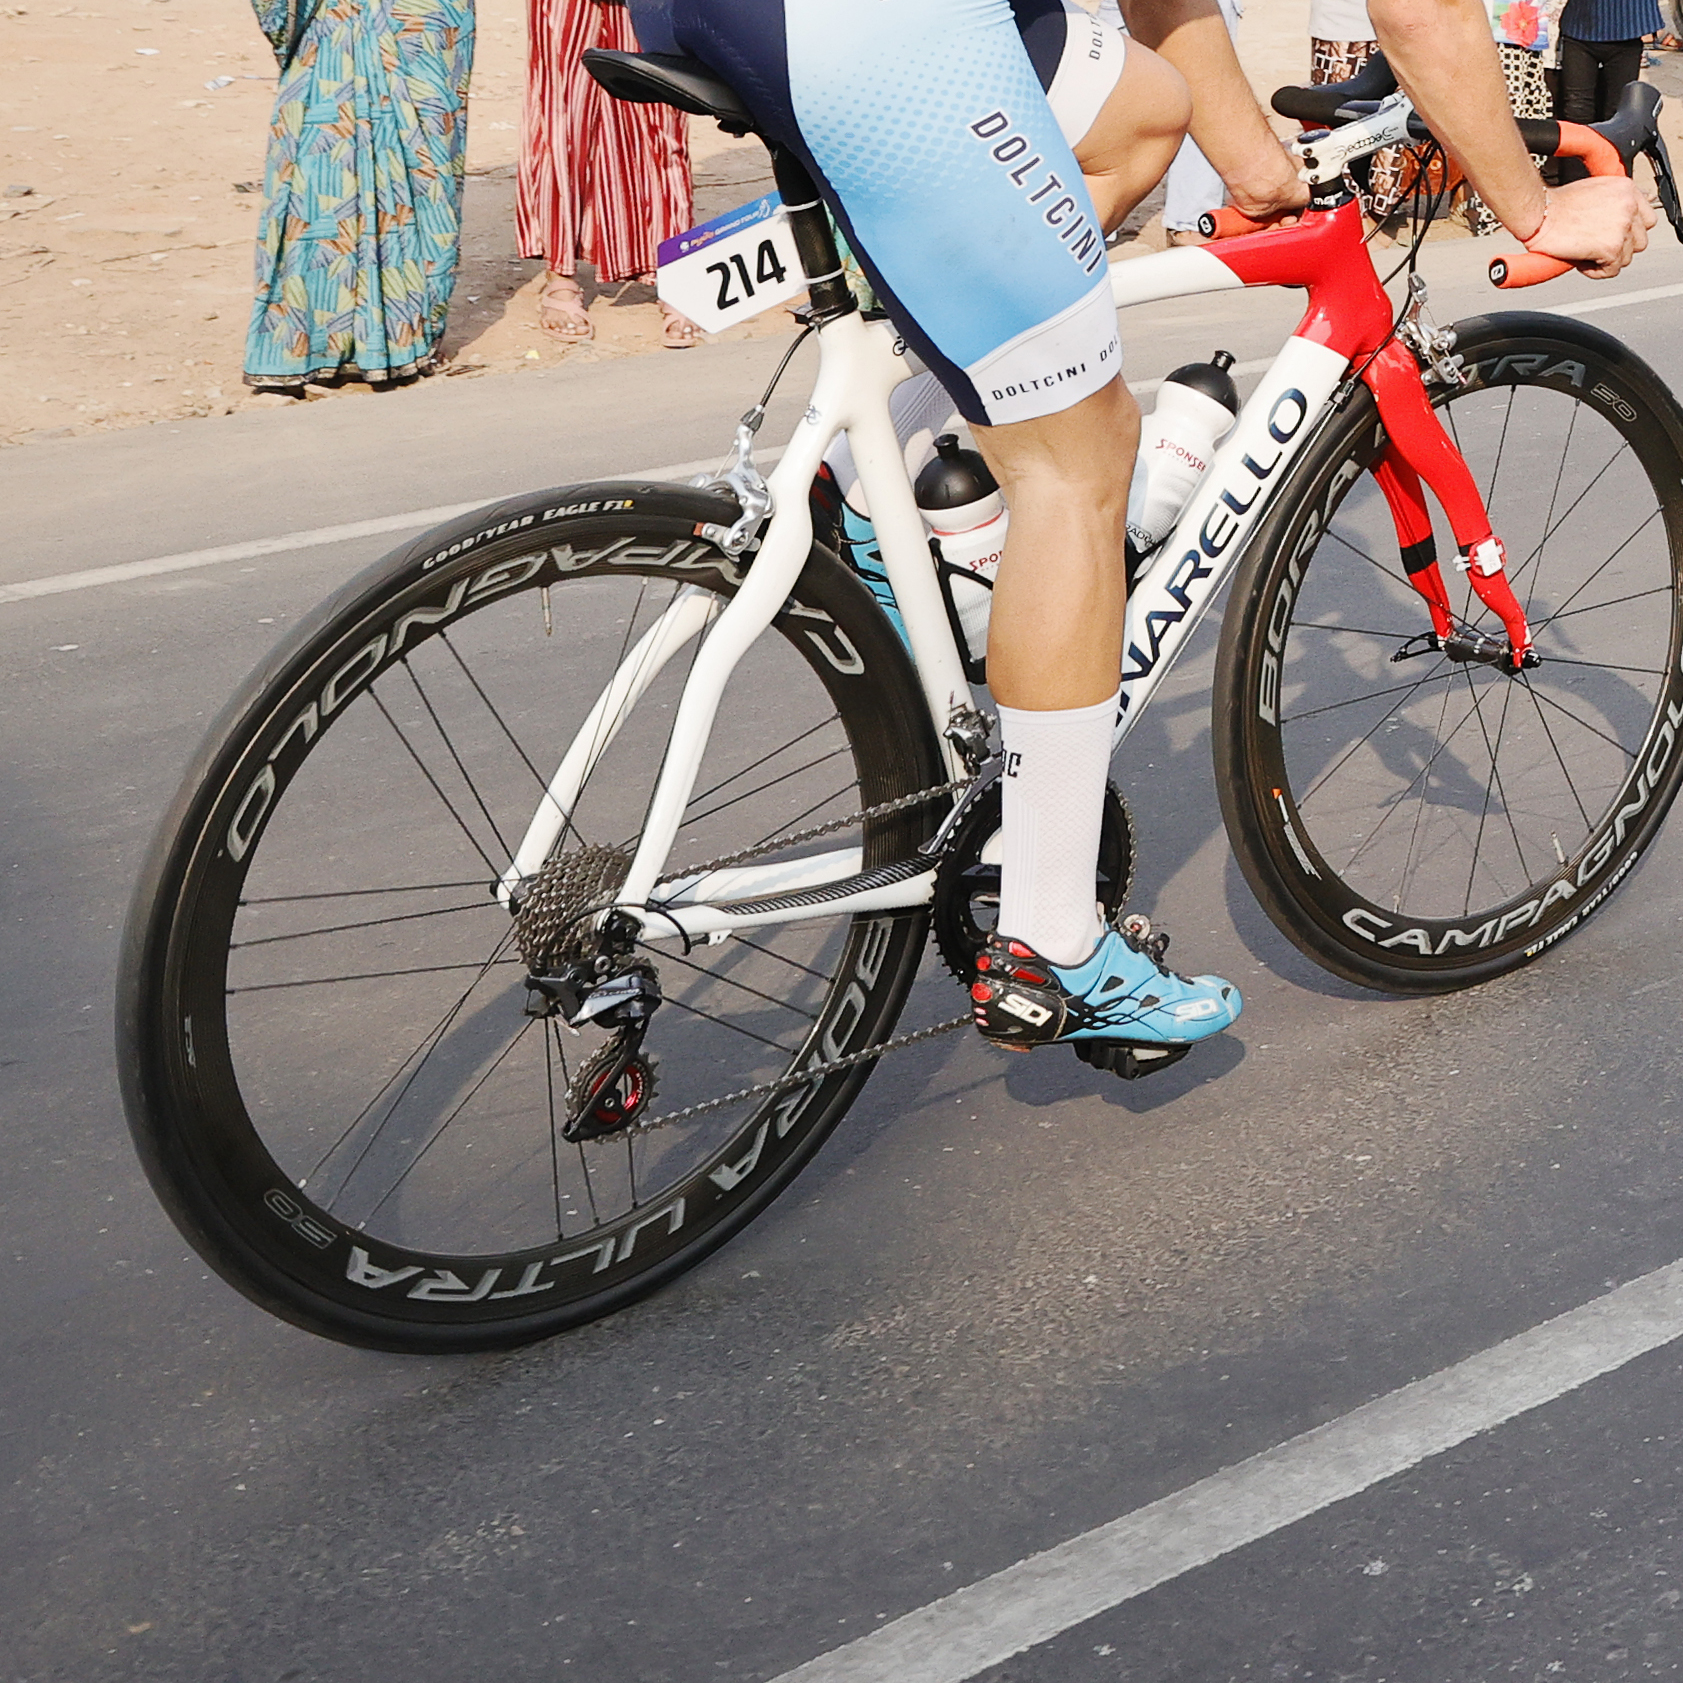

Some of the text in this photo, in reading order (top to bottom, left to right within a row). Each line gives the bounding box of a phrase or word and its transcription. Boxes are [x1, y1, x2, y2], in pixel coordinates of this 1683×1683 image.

[970, 111, 1105, 274] DOLTCINI
[706, 239, 787, 310] 214
[992, 362, 1088, 400] DOLTCINI
[1590, 382, 1638, 422] 50
[1154, 437, 1207, 473] SPONSE
[422, 515, 535, 570] GOODYEAR
[541, 500, 602, 522] EAGLE
[968, 549, 1003, 573] SPO
[1115, 387, 1308, 727] NARELLO
[1259, 458, 1361, 728] BORA
[225, 535, 866, 864] CMPAGNOLO
[708, 917, 895, 1194] BORA
[346, 1197, 686, 1303] ULTRA
